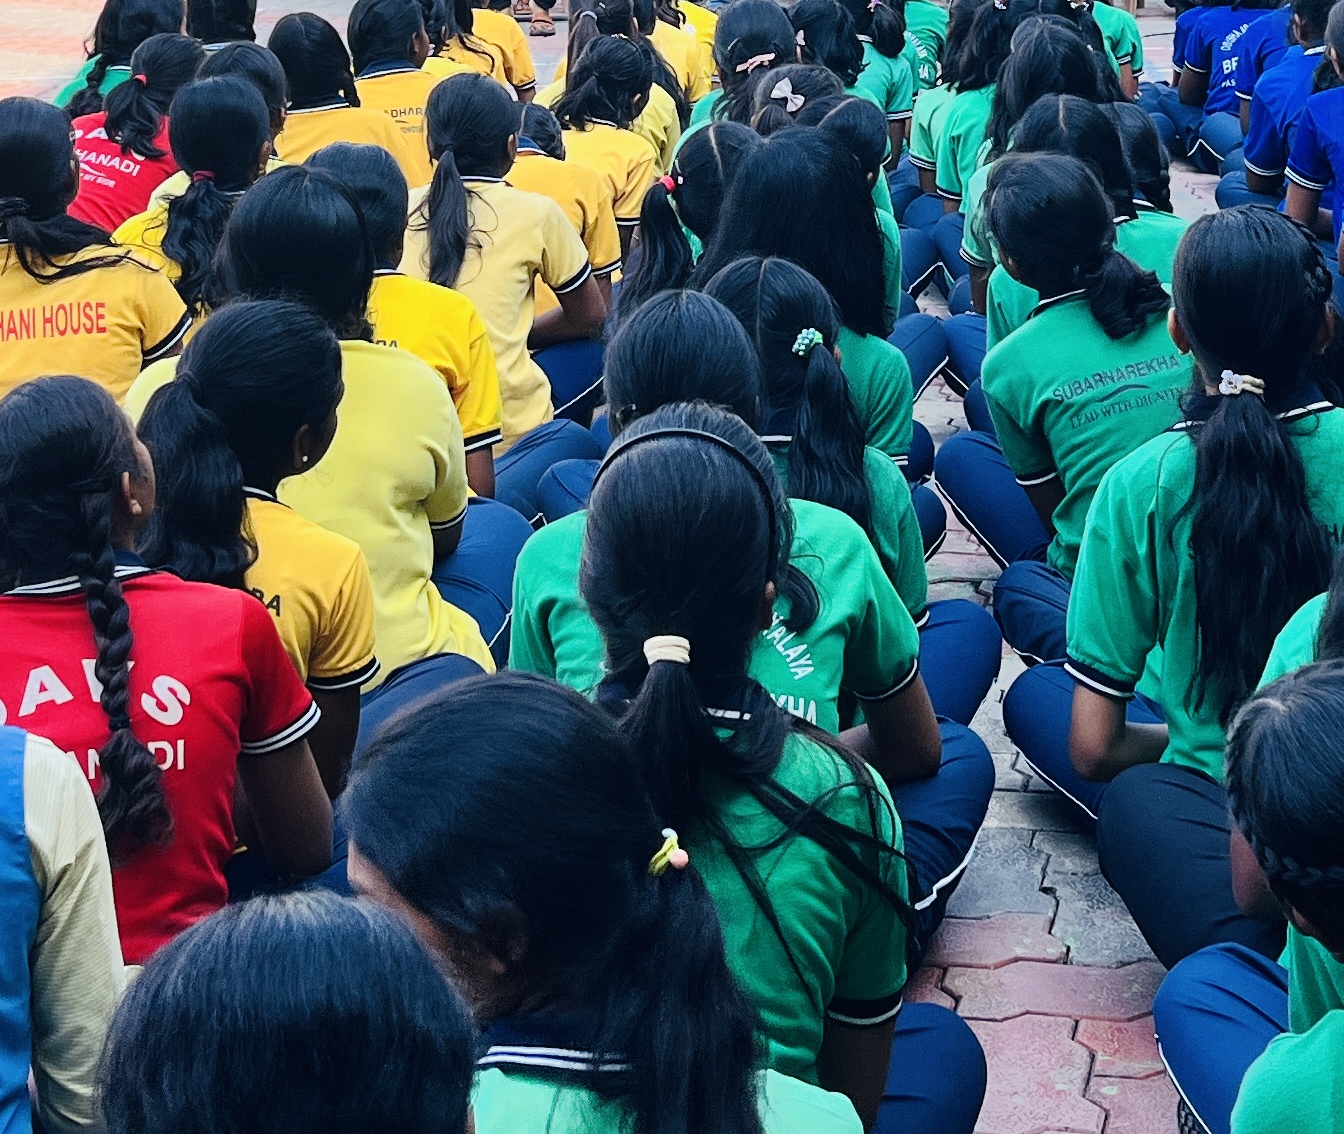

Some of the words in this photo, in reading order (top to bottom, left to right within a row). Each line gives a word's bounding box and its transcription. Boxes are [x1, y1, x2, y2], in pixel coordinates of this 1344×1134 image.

[75, 148, 141, 177] HANADI
[42, 301, 108, 338] HOUSE
[1053, 354, 1181, 404] SUBARNAREKHA
[762, 611, 815, 680] YALAYA
